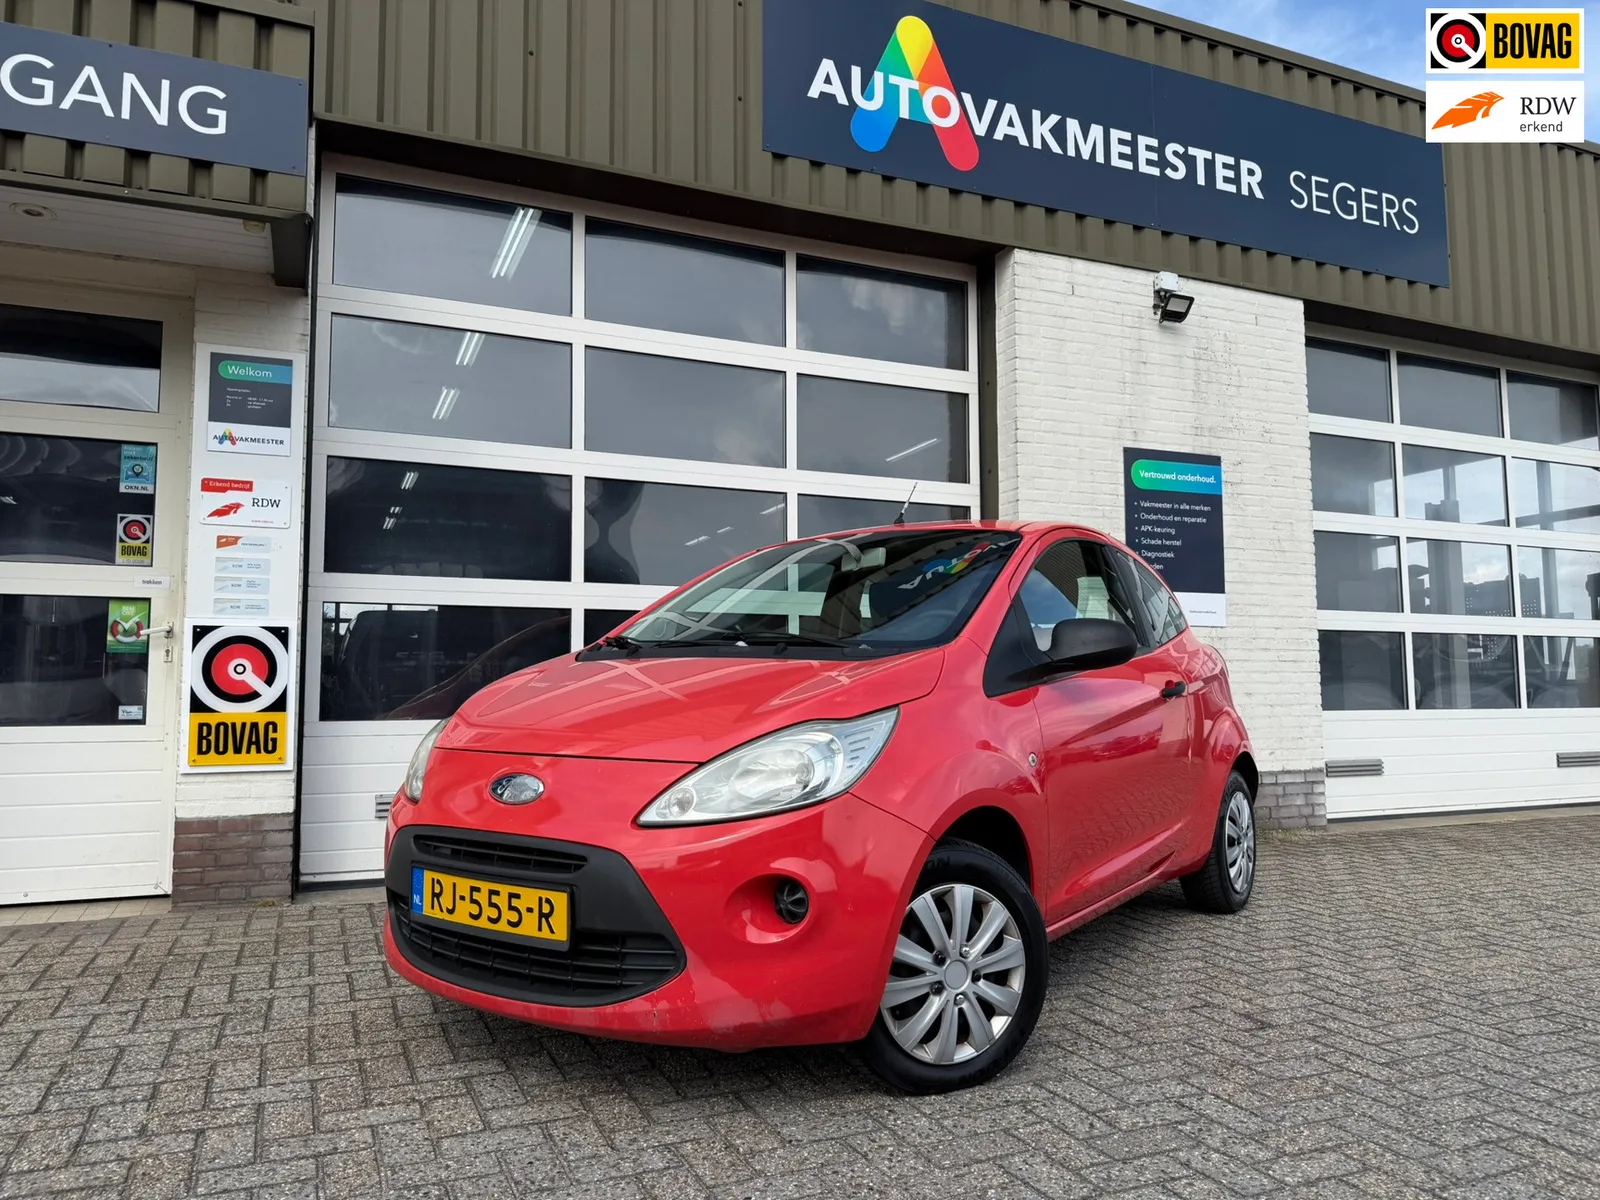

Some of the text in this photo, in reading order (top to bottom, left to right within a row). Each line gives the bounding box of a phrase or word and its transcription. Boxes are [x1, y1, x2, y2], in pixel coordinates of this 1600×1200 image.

[807, 57, 1419, 235] AUTOVAKMEESTER SEGERS
[227, 365, 273, 378] Welkom
[212, 434, 285, 446] AUTOVAKMEESTER
[1139, 470, 1217, 484] Vertrouwd onderhoud.
[251, 497, 281, 508] RDW
[1140, 501, 1172, 509] Vakmeester
[1140, 512, 1173, 520] Onderhoud
[1182, 515, 1207, 524] reparatie
[1141, 525, 1175, 535] APK-keuring
[1141, 537, 1162, 545] Schade
[121, 545, 147, 557] BOVAG
[1141, 549, 1175, 559] Diagnostiek
[197, 721, 278, 755] BOVAG
[413, 894, 422, 906] NL
[430, 876, 556, 934] RJ-555-R
